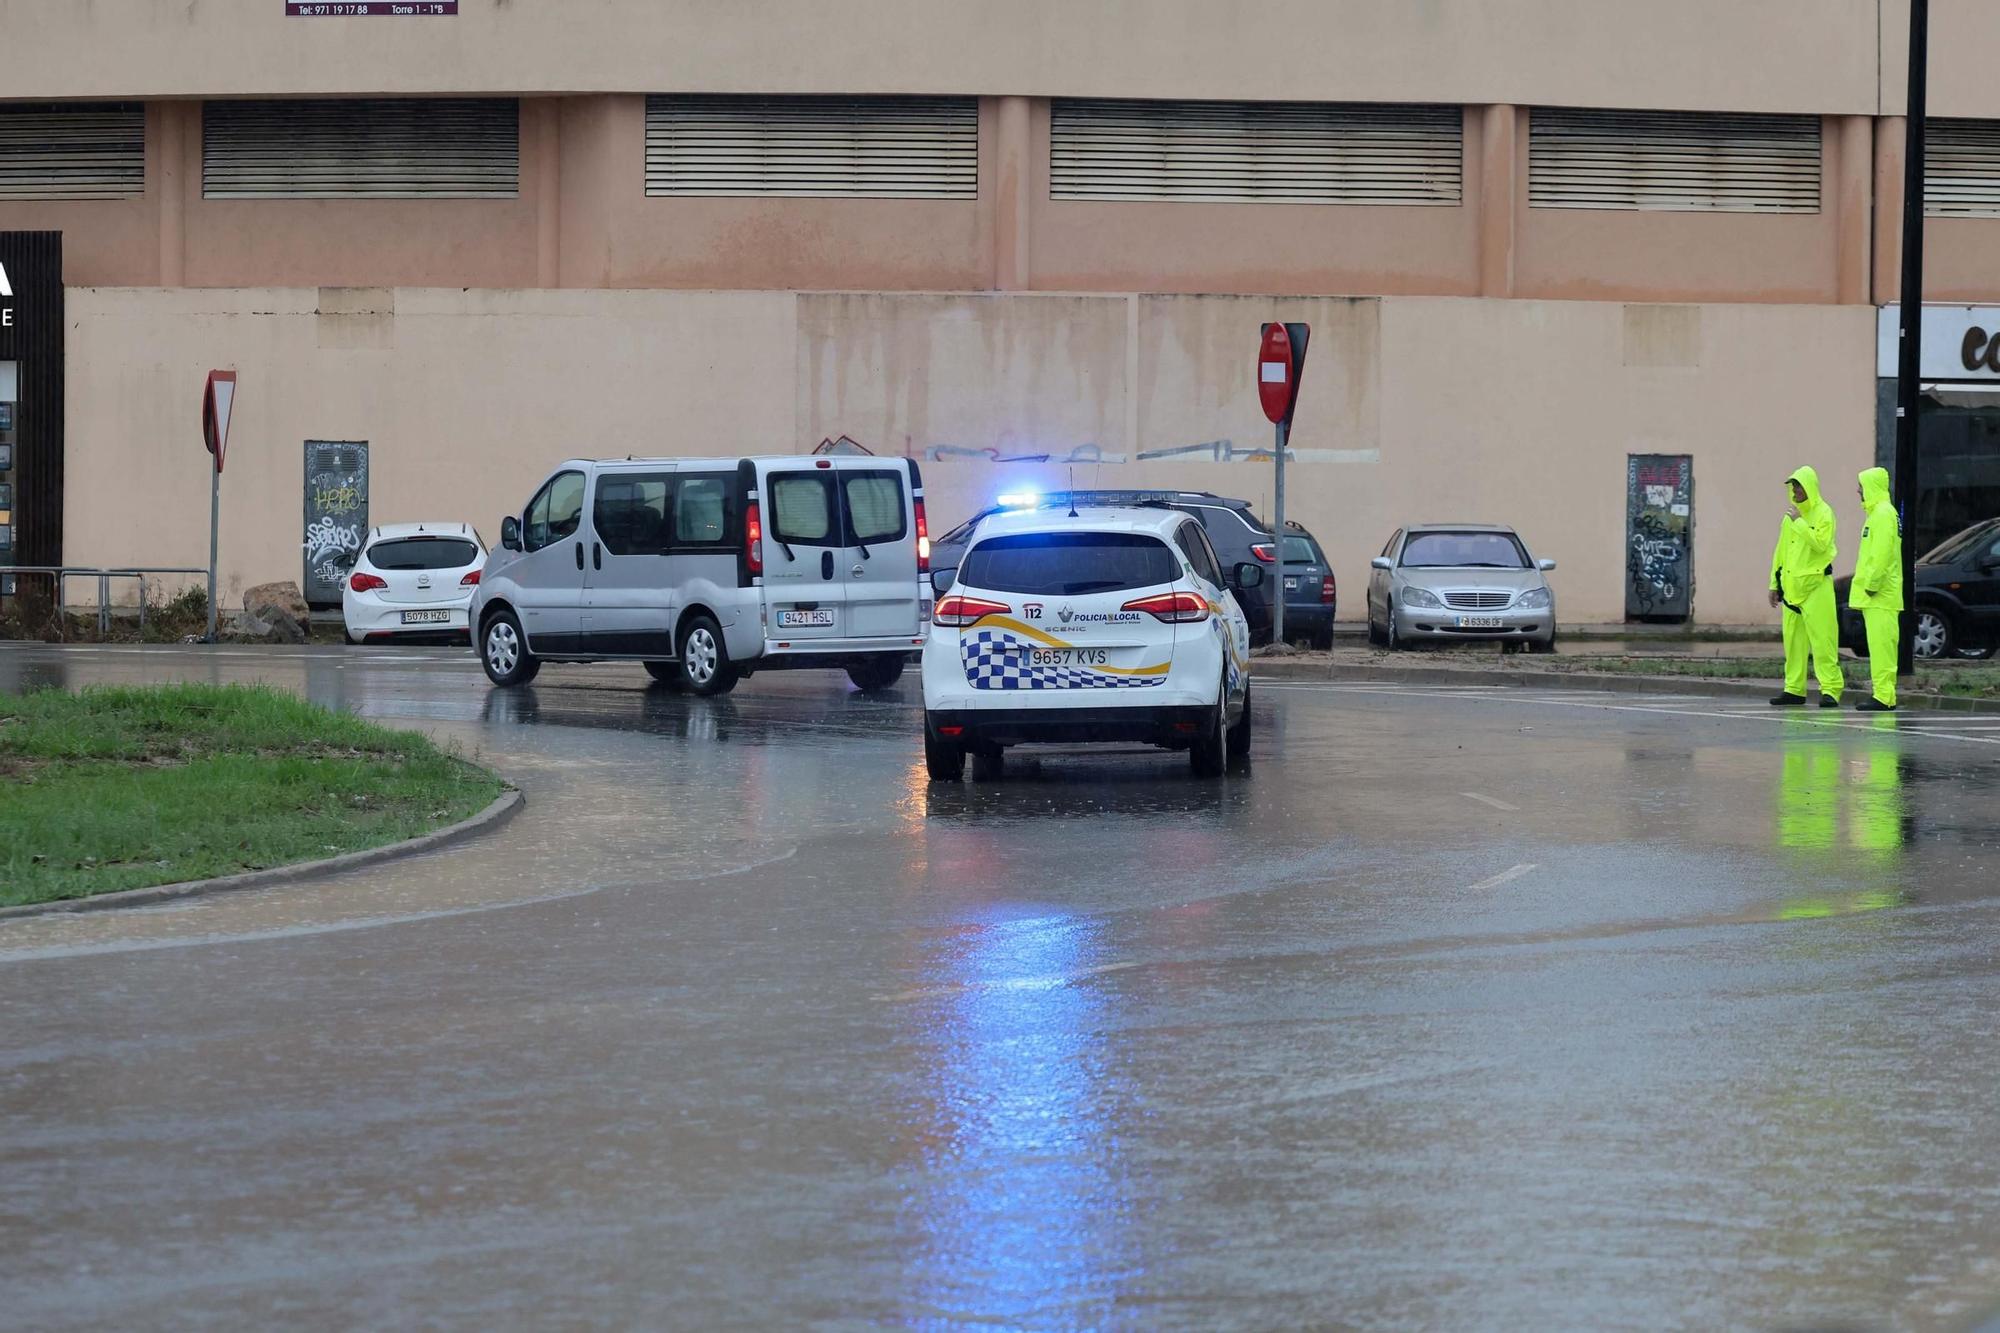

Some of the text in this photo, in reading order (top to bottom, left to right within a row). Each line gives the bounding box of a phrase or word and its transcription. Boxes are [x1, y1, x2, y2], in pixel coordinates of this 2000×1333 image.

[299, 5, 368, 15] Tel: 971 19 17 88
[392, 5, 413, 14] Torre
[406, 611, 448, 621] 5078 HZG
[785, 612, 831, 623] 9421 HSL
[1024, 608, 1042, 619] 112
[1074, 613, 1141, 622] POLICIA LOCAL
[1033, 650, 1106, 665] 9657 KVS
